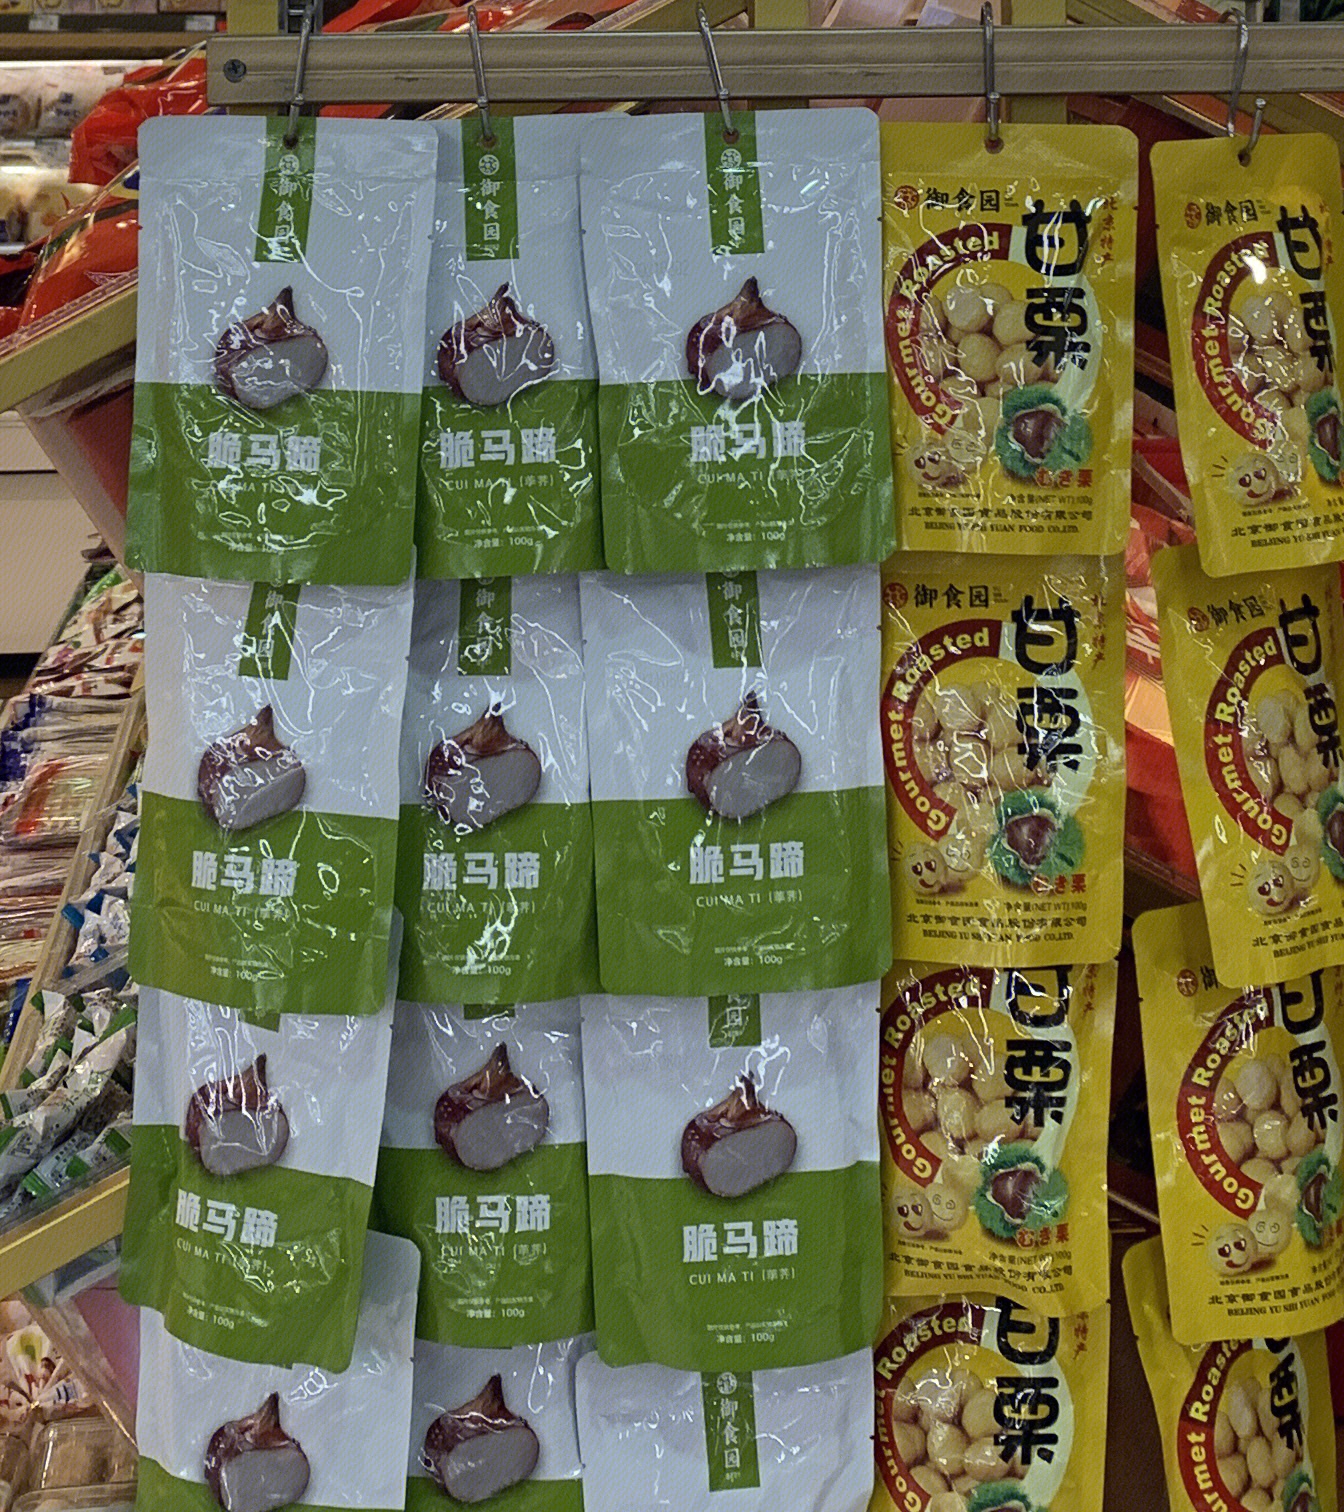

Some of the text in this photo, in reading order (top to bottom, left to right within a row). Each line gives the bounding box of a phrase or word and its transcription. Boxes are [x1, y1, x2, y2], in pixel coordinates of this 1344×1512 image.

[479, 178, 504, 241] 御食园
[925, 187, 1000, 212] 御食园
[1205, 198, 1258, 227] 御食园
[1021, 199, 1092, 372] 甘栗
[896, 304, 953, 426] Gourmet
[207, 432, 322, 472] 脆马蹄
[440, 427, 556, 469] 脆马蹄
[690, 421, 805, 463] 脆马蹄
[510, 536, 534, 547] 100g
[721, 580, 745, 648] 御食园
[913, 584, 990, 609] 御食园
[1207, 595, 1266, 627] 御食园
[1011, 594, 1084, 774] 甘栗
[1278, 593, 1344, 769] 甘栗
[887, 627, 990, 832] Gourmet Roasted
[1212, 635, 1288, 847] Gourmet Roasted
[191, 850, 298, 898] 脆马蹄
[422, 852, 540, 890] 脆马蹄
[689, 840, 804, 885] 脆马蹄
[194, 900, 210, 913] CUI
[213, 904, 229, 915] MA
[696, 895, 718, 908] CUI
[749, 893, 761, 904] TI
[759, 955, 783, 966] 100g
[881, 975, 981, 1179] Gourmet Roasted
[1186, 1094, 1255, 1211] Gourmet
[175, 1188, 279, 1248] 脆马蹄
[435, 1194, 551, 1234] 脆马蹄
[176, 1237, 191, 1252] CUI
[194, 1245, 209, 1260] MA
[682, 1218, 799, 1263] 脆马蹄
[689, 1273, 712, 1286] CUI
[717, 1272, 737, 1284] MA
[742, 1270, 754, 1282] TI
[213, 1314, 235, 1330] 100g
[501, 1308, 525, 1318] 100g
[1227, 1305, 1267, 1317] BEIJING
[1269, 1304, 1282, 1315] YU
[751, 1332, 775, 1343] 100g
[875, 1314, 972, 1381] Roasted
[1265, 1338, 1304, 1451] 栗
[720, 1397, 741, 1469] 御食园
